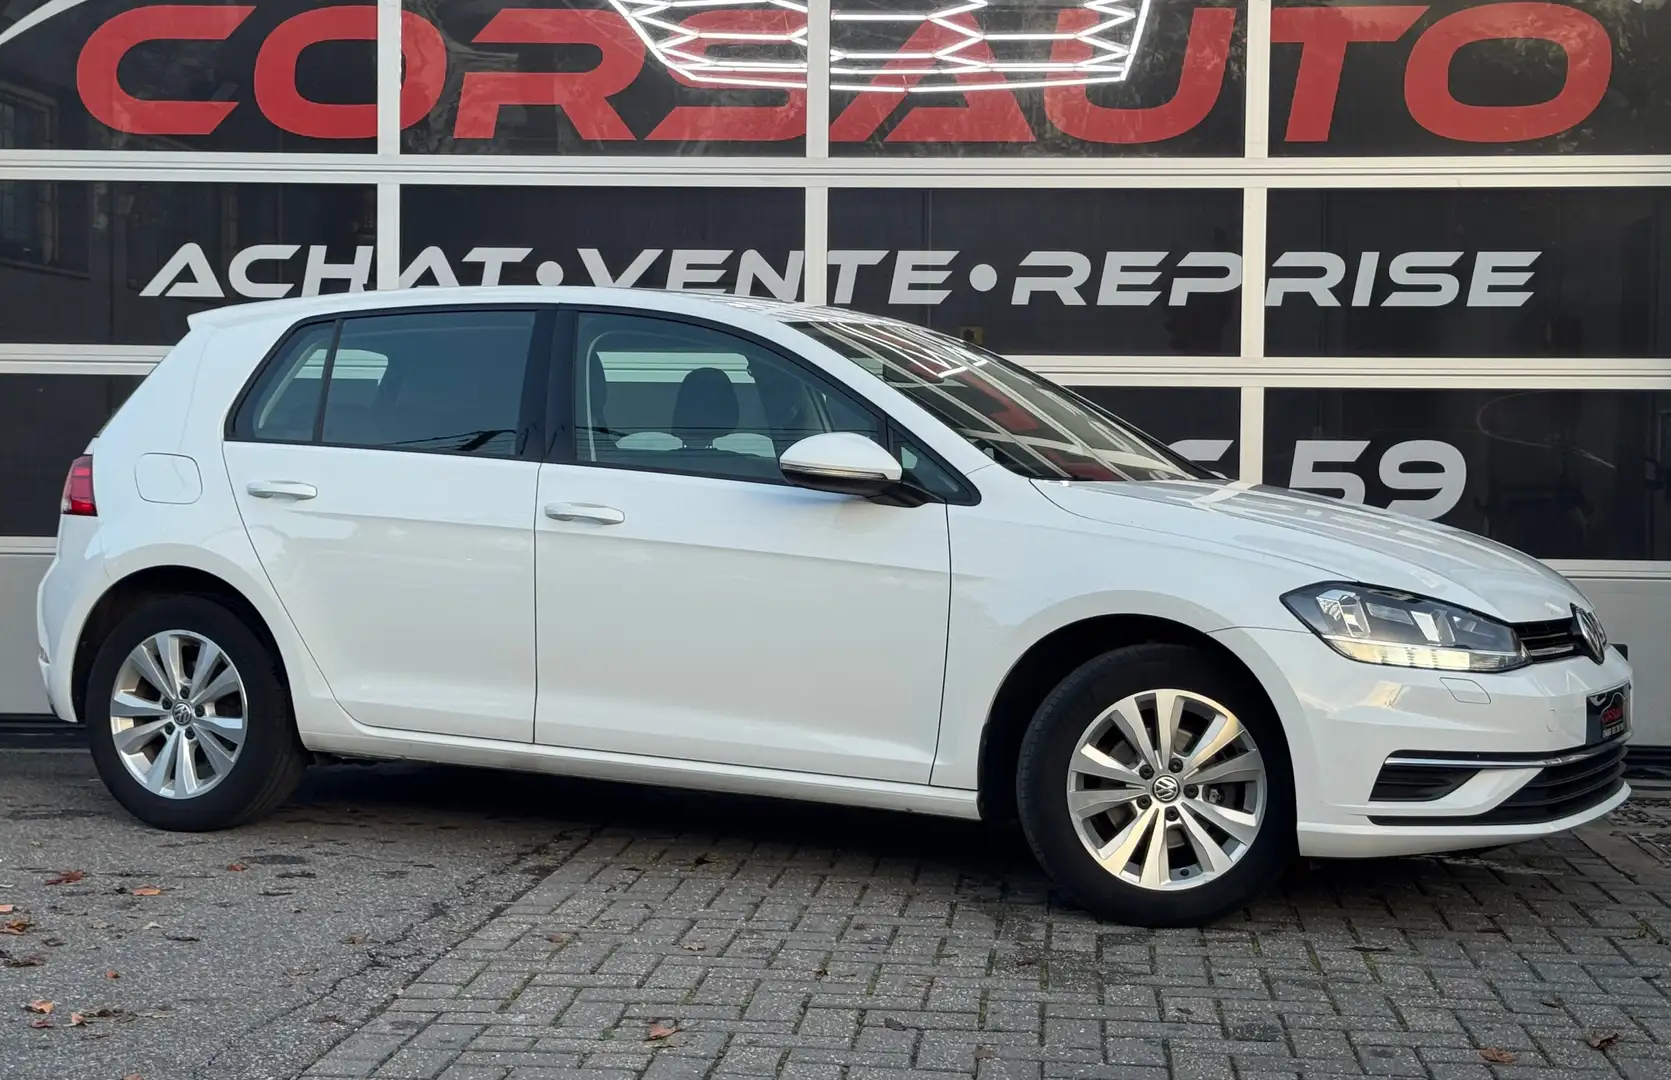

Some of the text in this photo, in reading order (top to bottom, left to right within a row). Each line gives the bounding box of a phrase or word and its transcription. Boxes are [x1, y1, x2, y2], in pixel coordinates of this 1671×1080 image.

[76, 2, 1611, 142] CORSAUTO
[139, 242, 1543, 307] ACHAT VENTE REPRISE
[1288, 439, 1467, 520] 59
